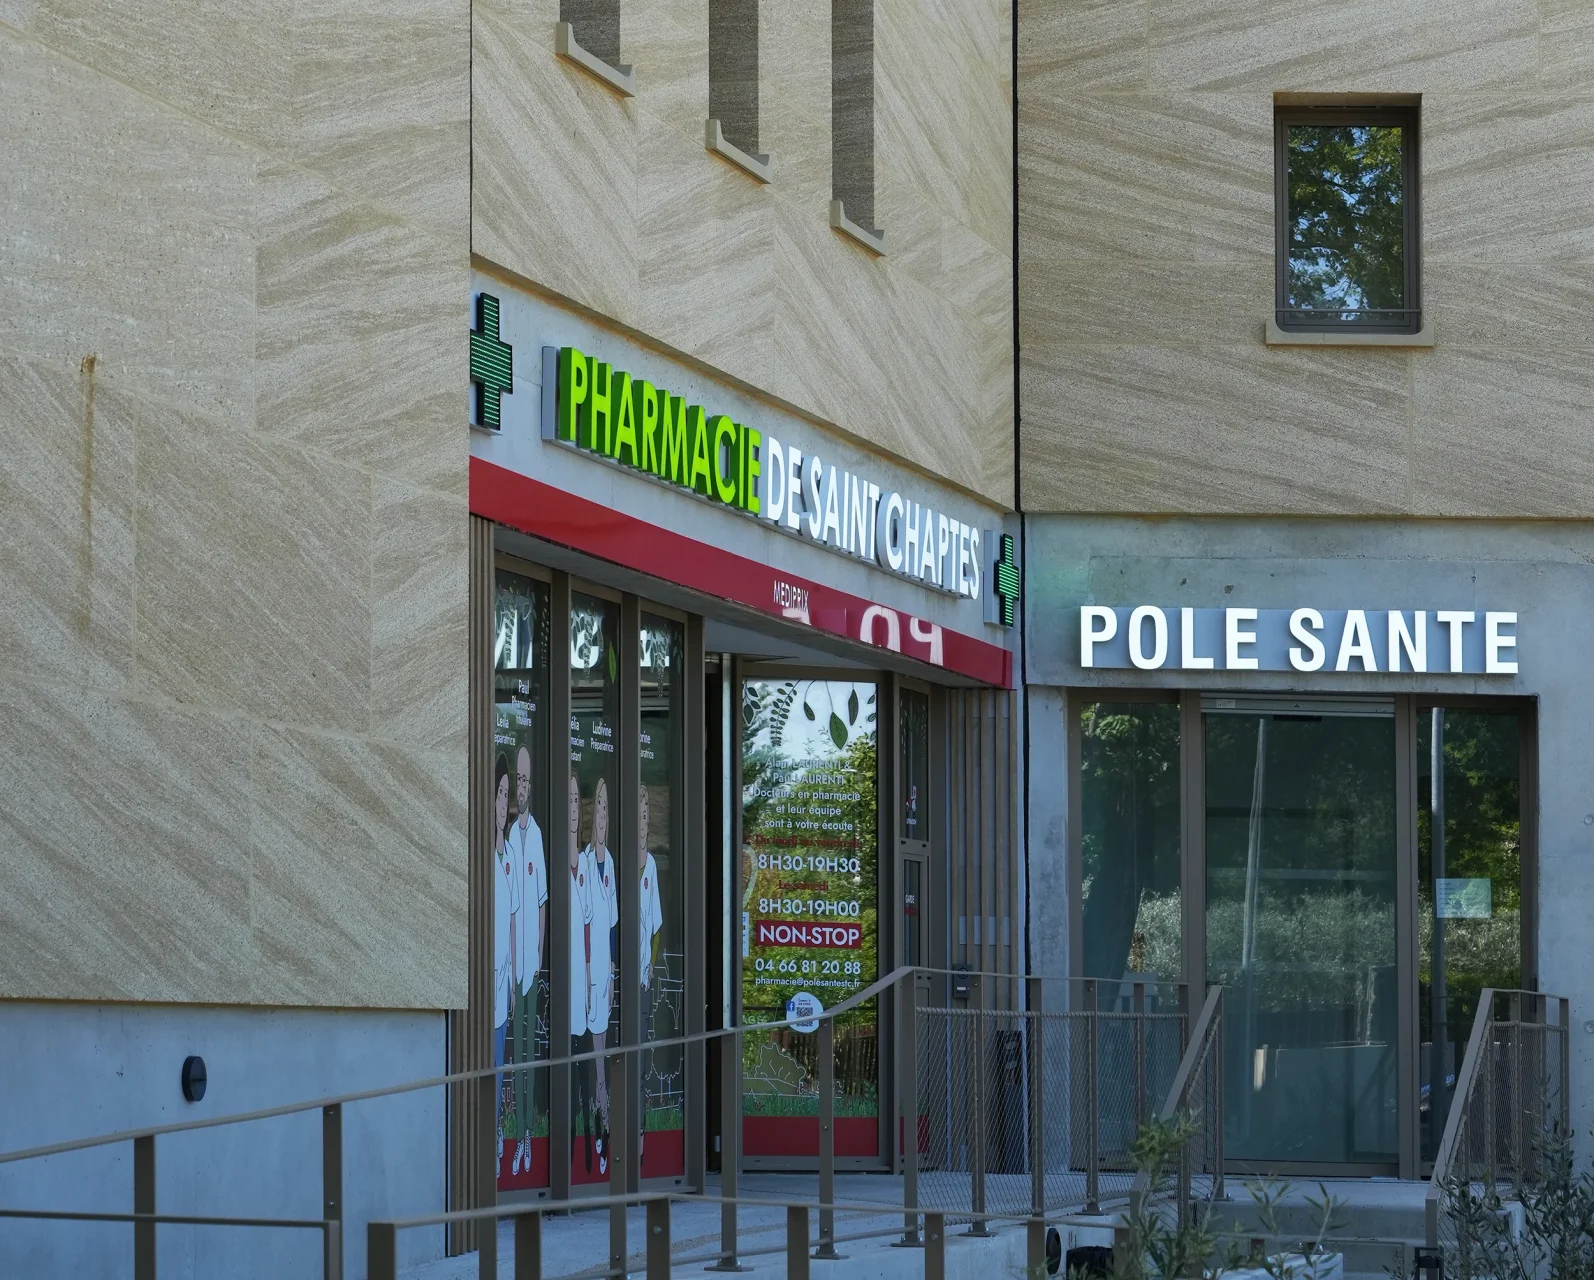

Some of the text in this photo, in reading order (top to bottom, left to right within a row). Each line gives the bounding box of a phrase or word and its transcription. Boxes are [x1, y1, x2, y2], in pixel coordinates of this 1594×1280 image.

[561, 347, 980, 600] PHARMACIE DE SAINT CHAPTES
[773, 580, 810, 613] MEDIPRIX
[1080, 605, 1518, 674] POLE SANTE
[518, 679, 530, 695] Paul
[592, 720, 612, 737] Ludivine
[752, 786, 861, 802] Docteurs en pharmacie
[775, 803, 842, 818] et leur équipe
[764, 818, 853, 831] sont à votre écoute
[757, 853, 860, 873] 8H30-19H30
[778, 879, 829, 891] Le samedi
[758, 897, 860, 917] 8H30-19H00
[760, 924, 860, 946] NON-STOP
[755, 958, 861, 975] 04 66 81 20 88
